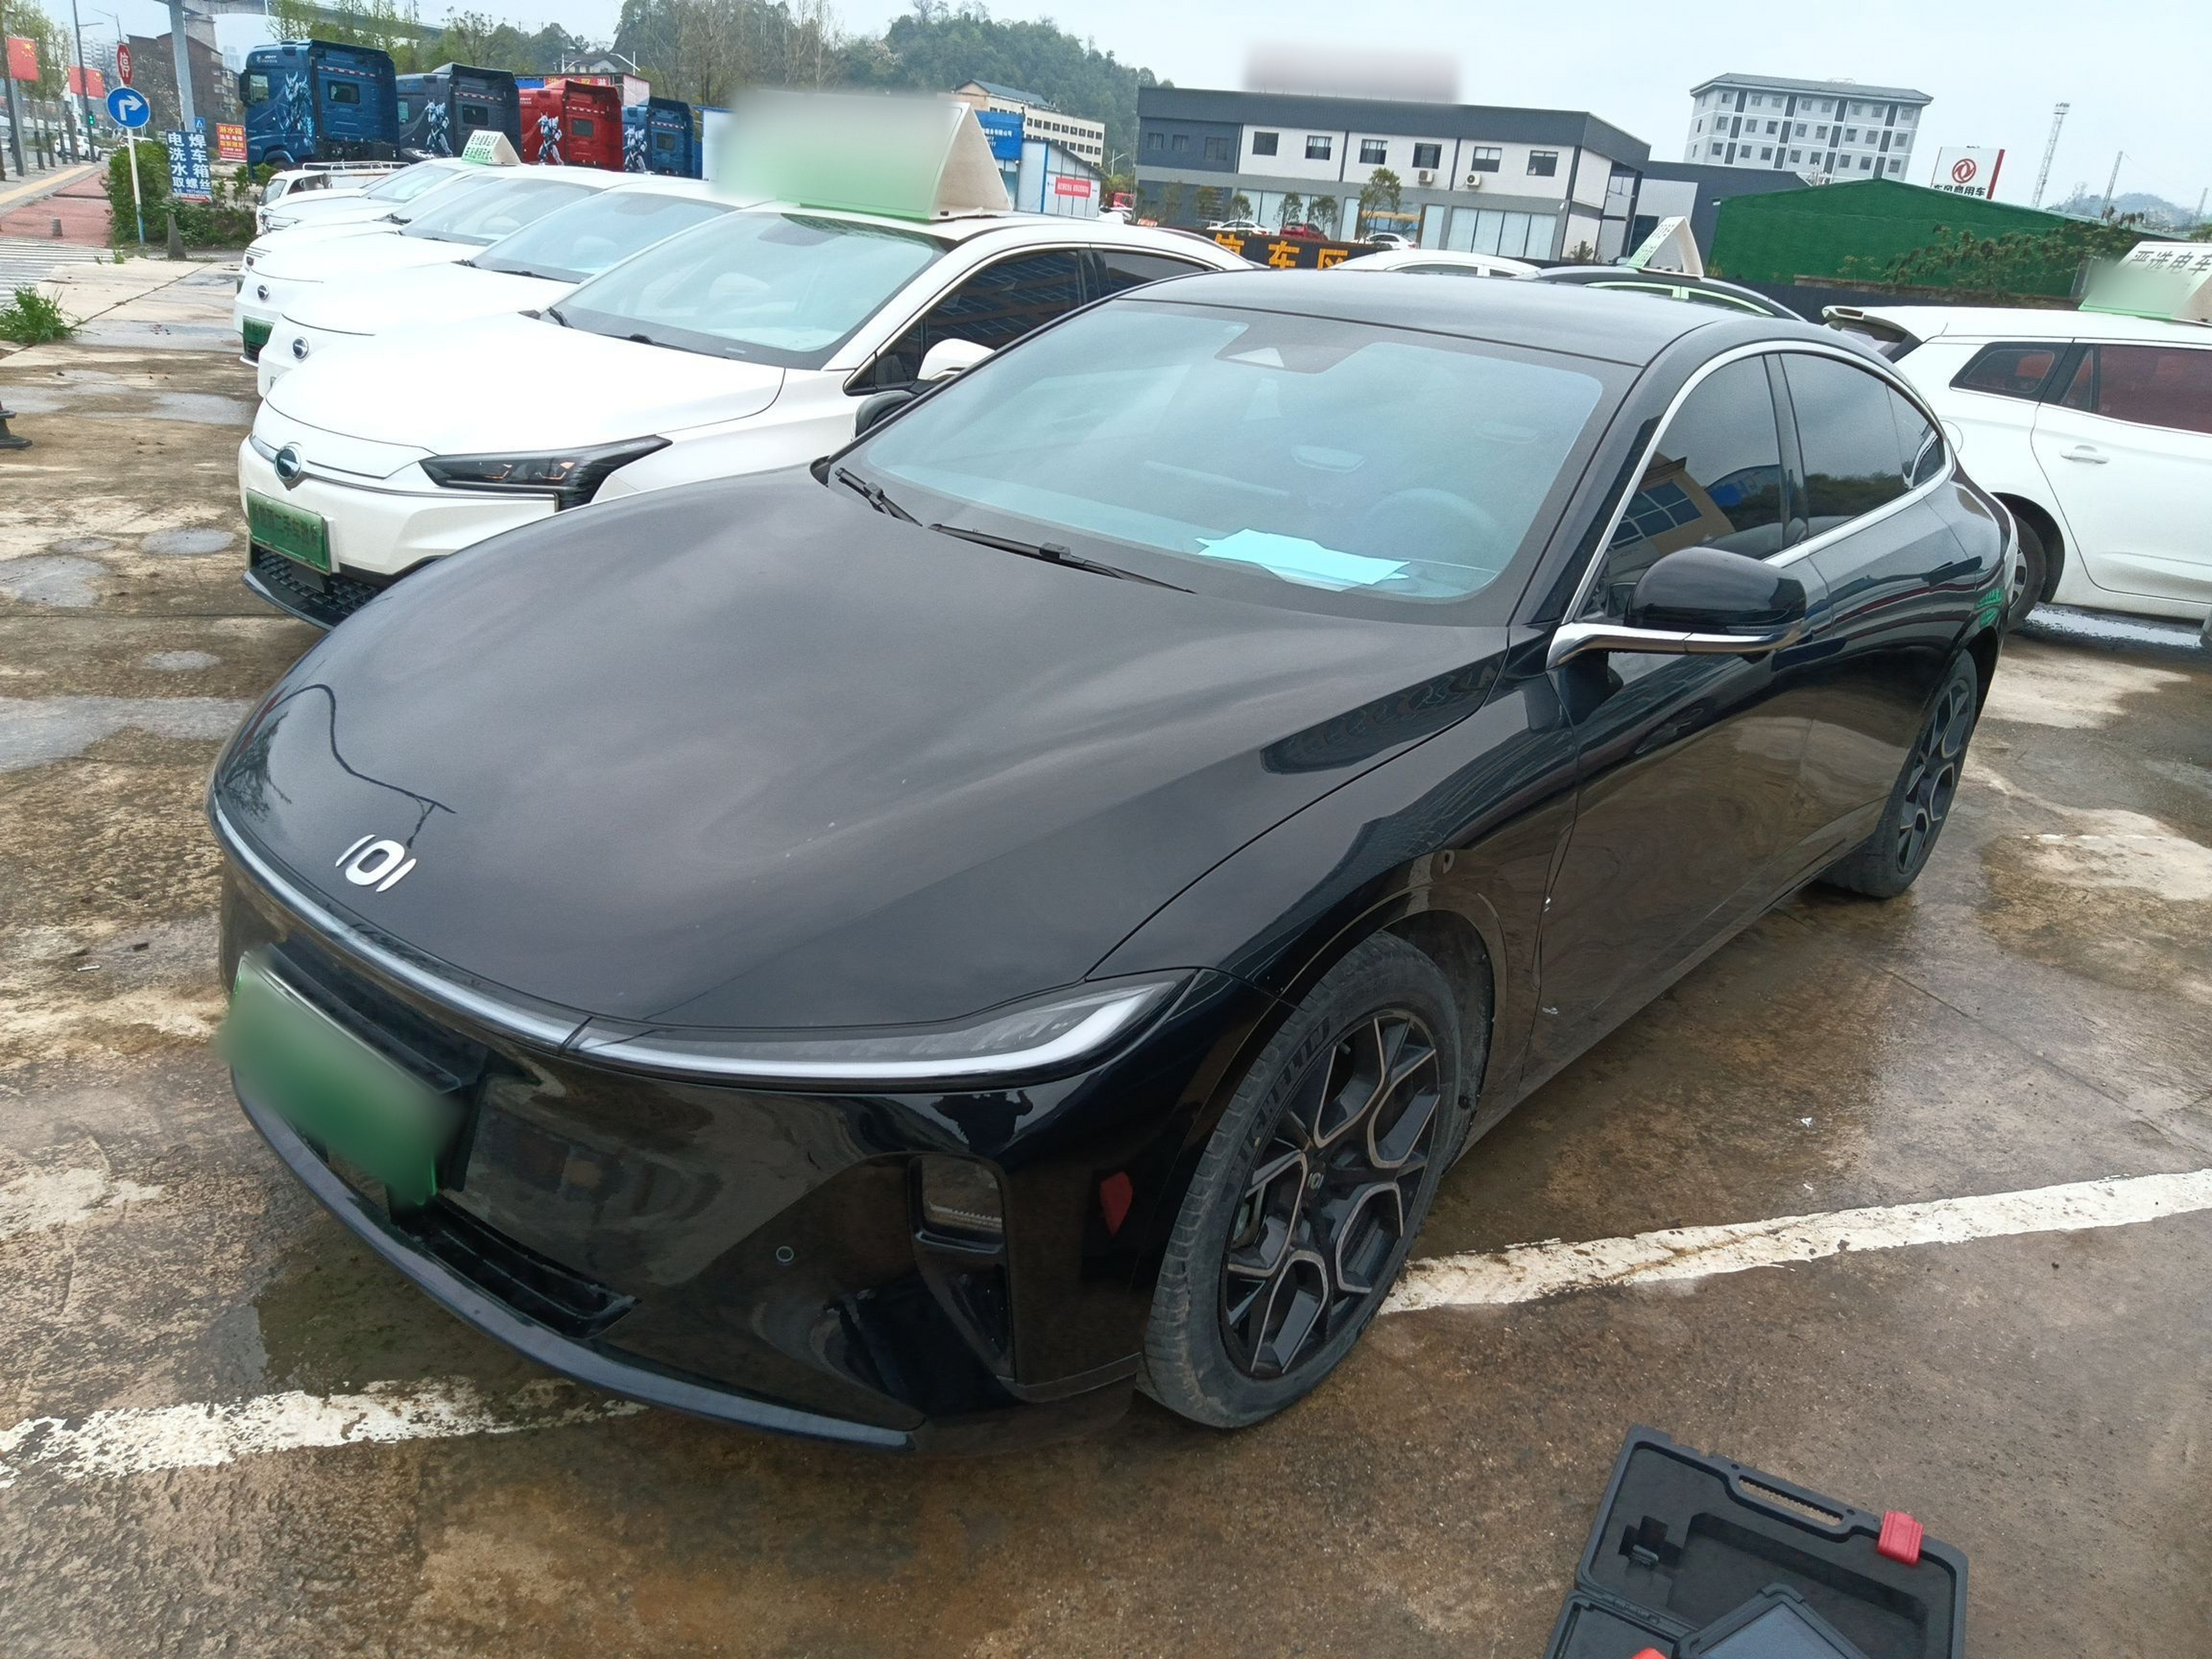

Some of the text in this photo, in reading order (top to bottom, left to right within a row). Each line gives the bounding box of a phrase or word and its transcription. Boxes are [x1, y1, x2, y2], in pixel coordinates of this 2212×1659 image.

[120, 52, 130, 78] 停
[168, 132, 207, 148] 电焊
[169, 147, 208, 164] 洗车
[171, 162, 210, 178] 水箱
[172, 176, 211, 190] 取螺丝
